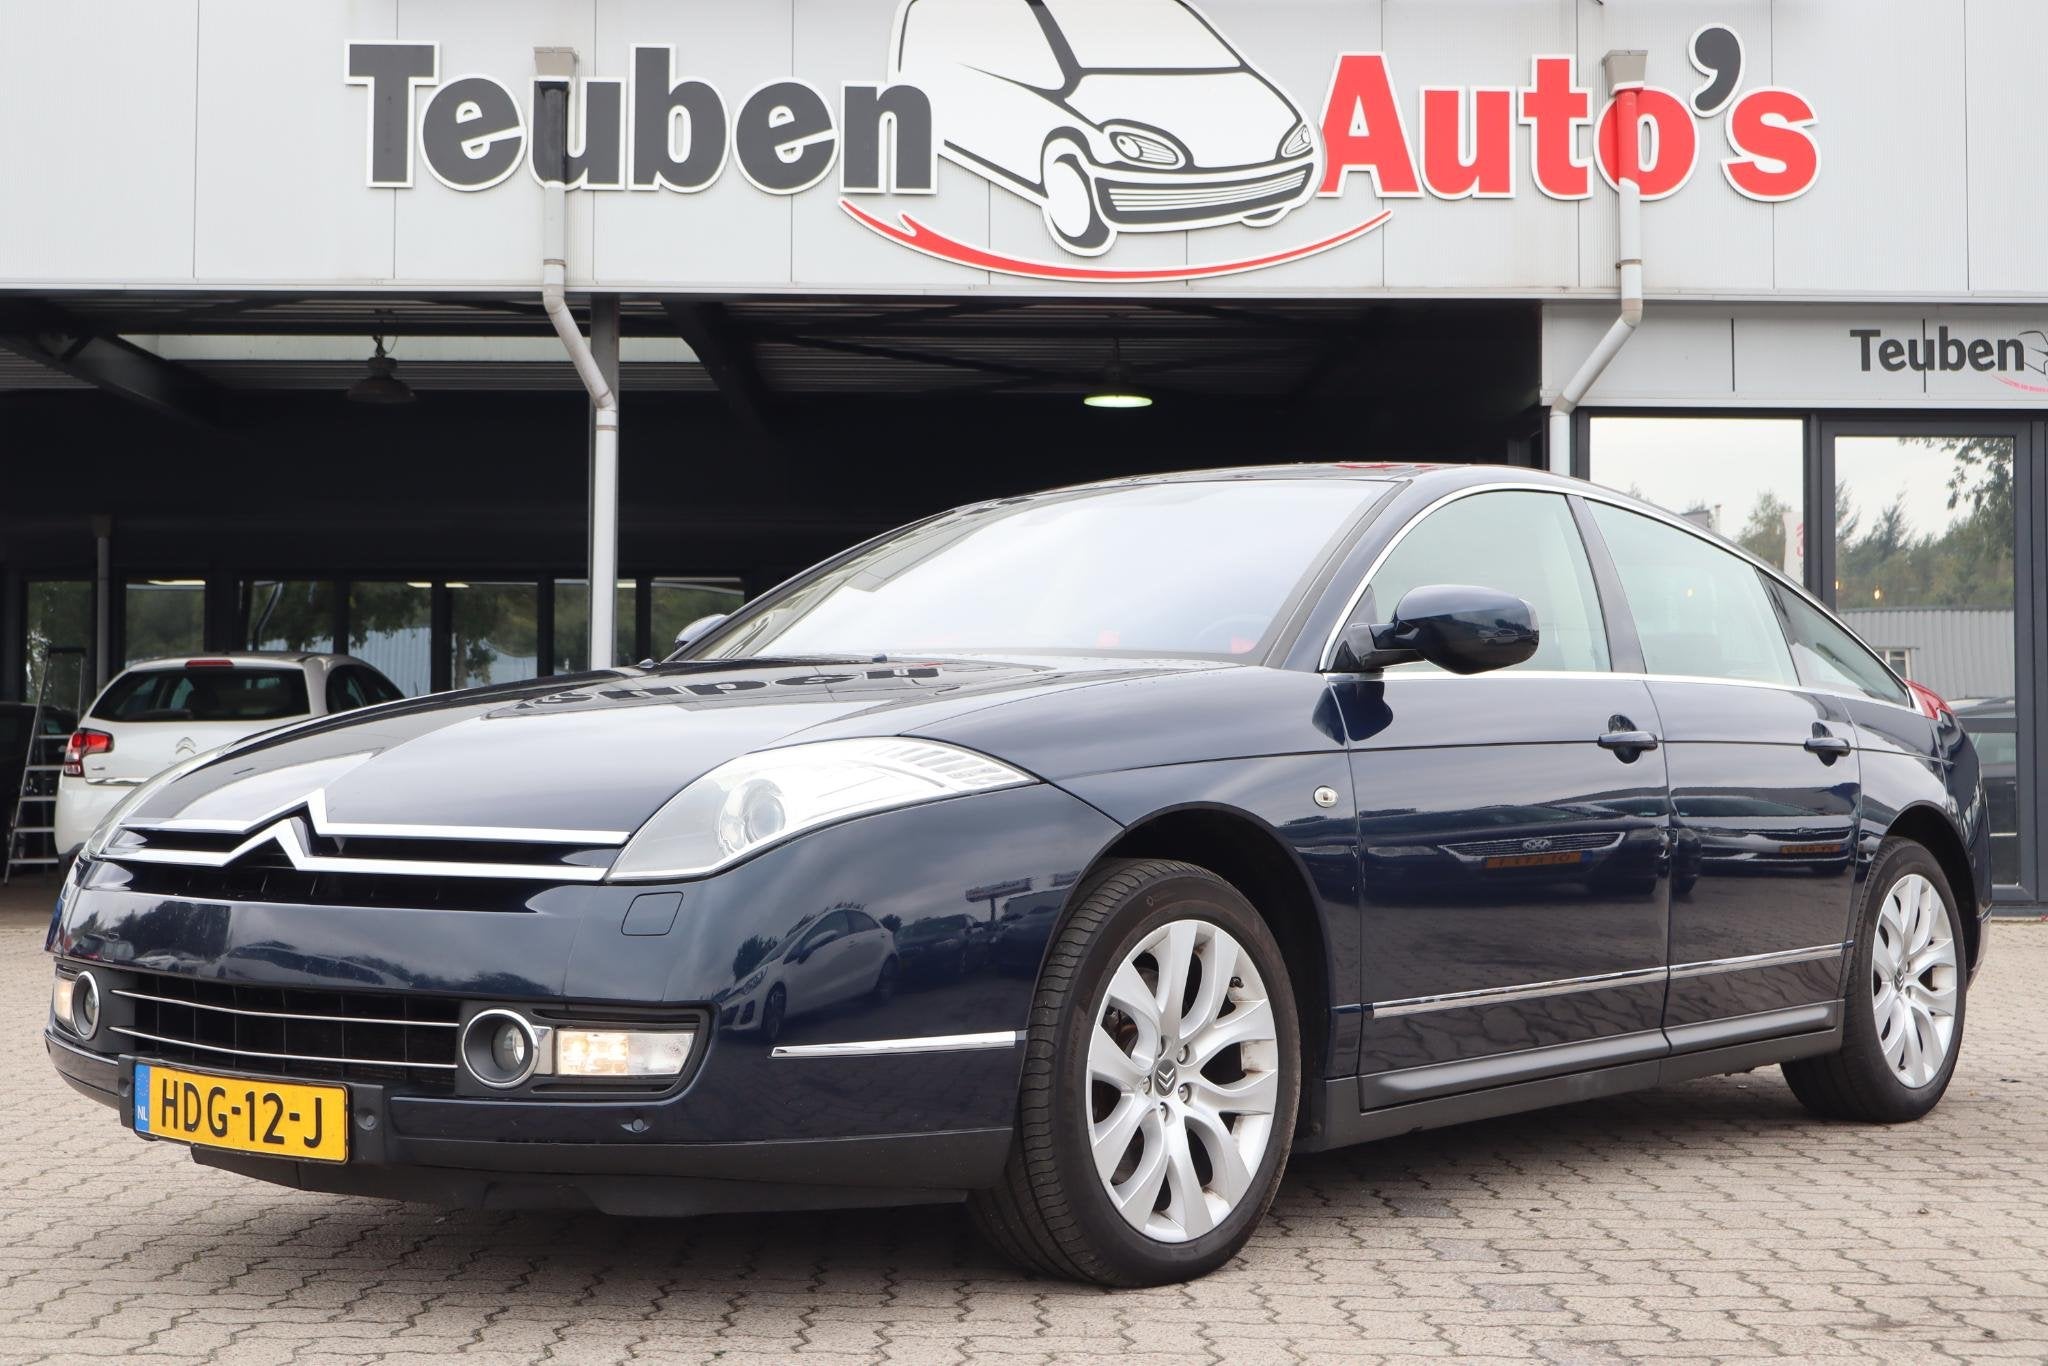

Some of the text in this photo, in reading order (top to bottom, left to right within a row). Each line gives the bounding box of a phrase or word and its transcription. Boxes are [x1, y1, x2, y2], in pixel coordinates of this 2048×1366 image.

[346, 26, 1820, 200] Teuben Auto's
[1850, 325, 2025, 372] Teuben
[137, 1104, 149, 1122] NL
[161, 1078, 323, 1149] HDG-12-J
